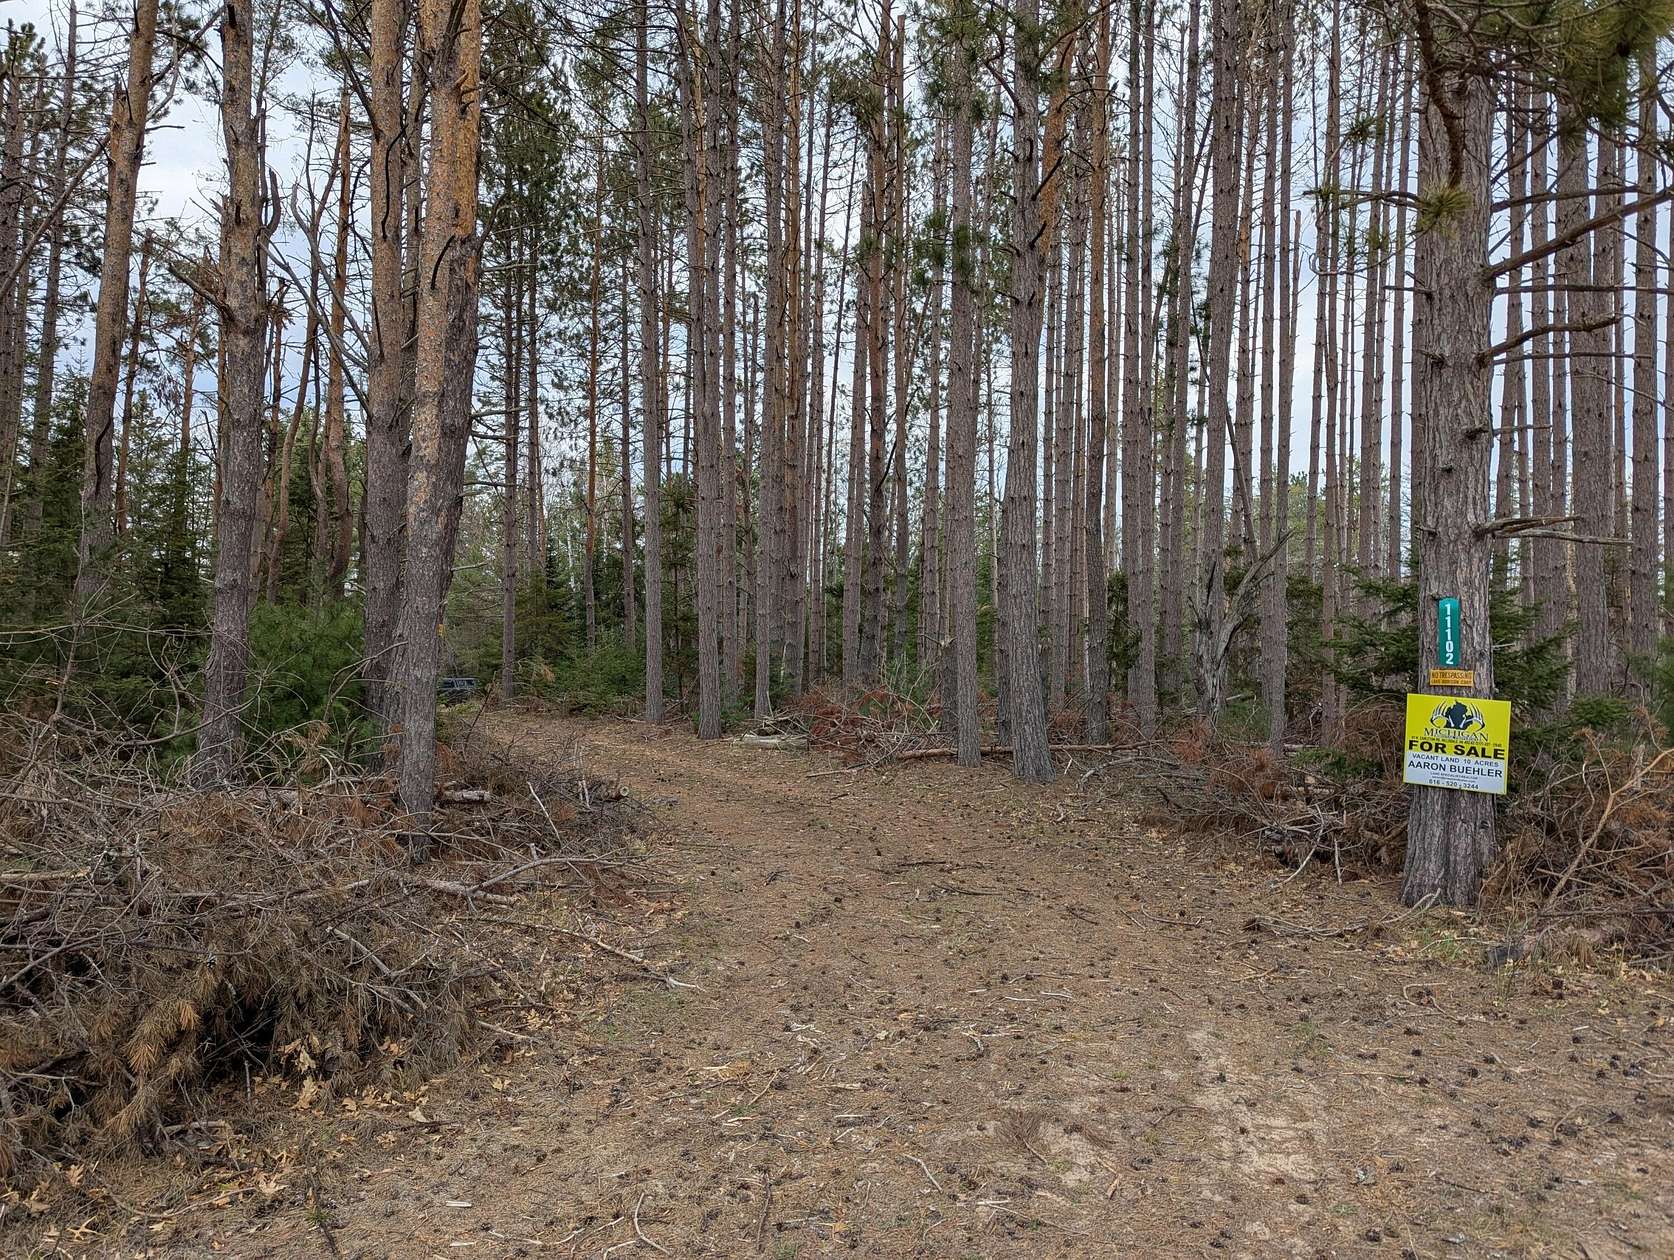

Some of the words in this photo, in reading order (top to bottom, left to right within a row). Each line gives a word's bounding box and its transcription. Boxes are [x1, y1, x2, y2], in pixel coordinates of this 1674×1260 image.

[1445, 603, 1454, 665] 11102
[1424, 728, 1489, 742] MICHIGAN
[1409, 740, 1447, 754] FOR
[1453, 744, 1505, 760] SALE
[1412, 753, 1439, 761] VACANT
[1408, 760, 1447, 772] AARON
[1449, 764, 1503, 778] BUEHLER
